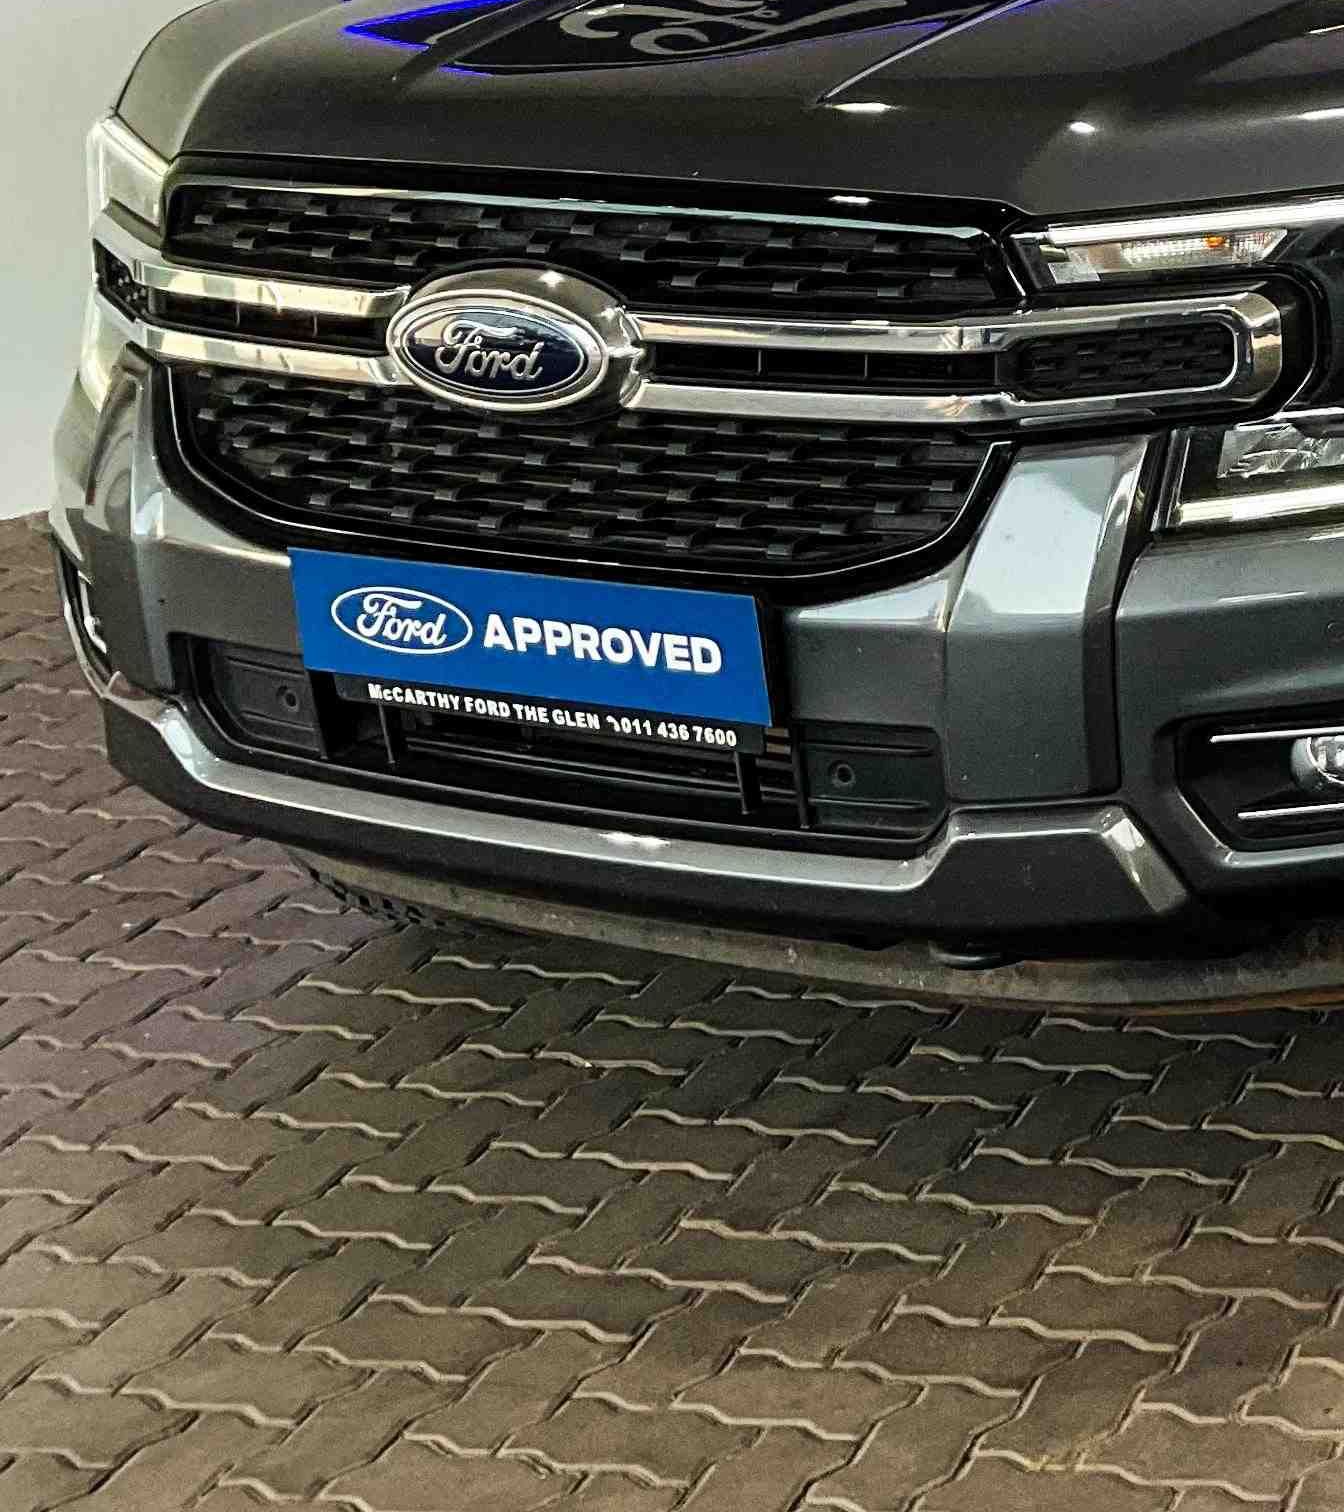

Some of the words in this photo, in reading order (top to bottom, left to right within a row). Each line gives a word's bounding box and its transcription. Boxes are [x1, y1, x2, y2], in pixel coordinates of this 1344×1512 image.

[434, 319, 545, 381] Ford
[356, 592, 448, 648] Ford
[483, 614, 723, 675] APPROVED
[368, 683, 460, 711] McCARTHY
[464, 696, 511, 718] FORD
[512, 703, 550, 724] THE
[552, 709, 600, 730] GLEN
[620, 716, 652, 736] 011
[657, 721, 690, 741] 436
[692, 725, 737, 747] 7600
